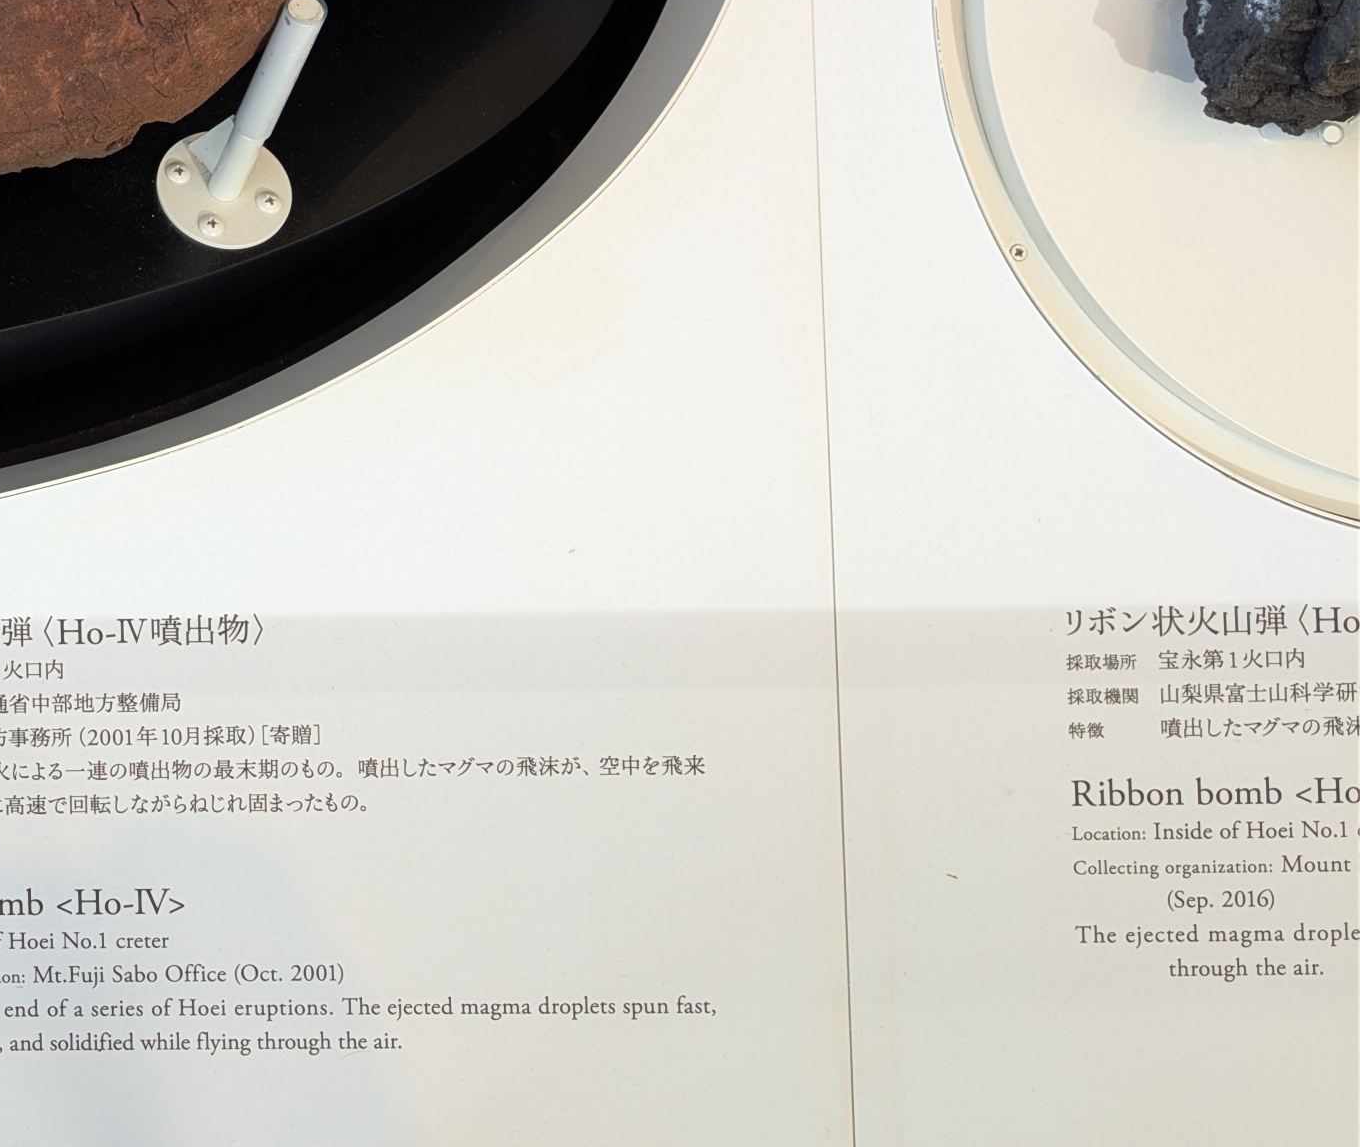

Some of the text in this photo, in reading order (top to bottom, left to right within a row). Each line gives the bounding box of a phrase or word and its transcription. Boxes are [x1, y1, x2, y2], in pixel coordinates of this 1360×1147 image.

[1066, 648, 1304, 671] 採取場所 宝永第1火口内
[1067, 682, 1357, 705] 採取機関 山梨県富士山科学研
[1069, 722, 1104, 739] 特徴
[1071, 778, 1184, 806] Ribbon
[1196, 776, 1282, 805] bomb
[1072, 826, 1145, 841] Location:
[1154, 821, 1212, 840] Inside
[1220, 820, 1241, 839] of
[1246, 821, 1294, 838] Hoei
[1301, 820, 1347, 838] No.1
[1073, 855, 1351, 879] Collecting organization: Mount
[1168, 889, 1274, 914] (Sep. 2016)
[8, 932, 54, 949] Hoei
[62, 932, 106, 949] No.1
[116, 936, 169, 949] creter
[1075, 922, 1360, 949] The ejected magma drople
[33, 966, 105, 989] Mt.Fuji
[112, 964, 157, 983] Sabo
[165, 964, 226, 982] Office
[235, 964, 282, 985] (Oct.
[291, 963, 343, 985] 2001)
[1169, 957, 1323, 982] through the air.
[10, 1033, 44, 1051] and
[50, 1032, 135, 1052] solidified
[140, 1032, 190, 1050] while
[197, 1032, 251, 1056] flying
[257, 1031, 332, 1055] through
[338, 1031, 367, 1049] the
[374, 1033, 402, 1049] air.
